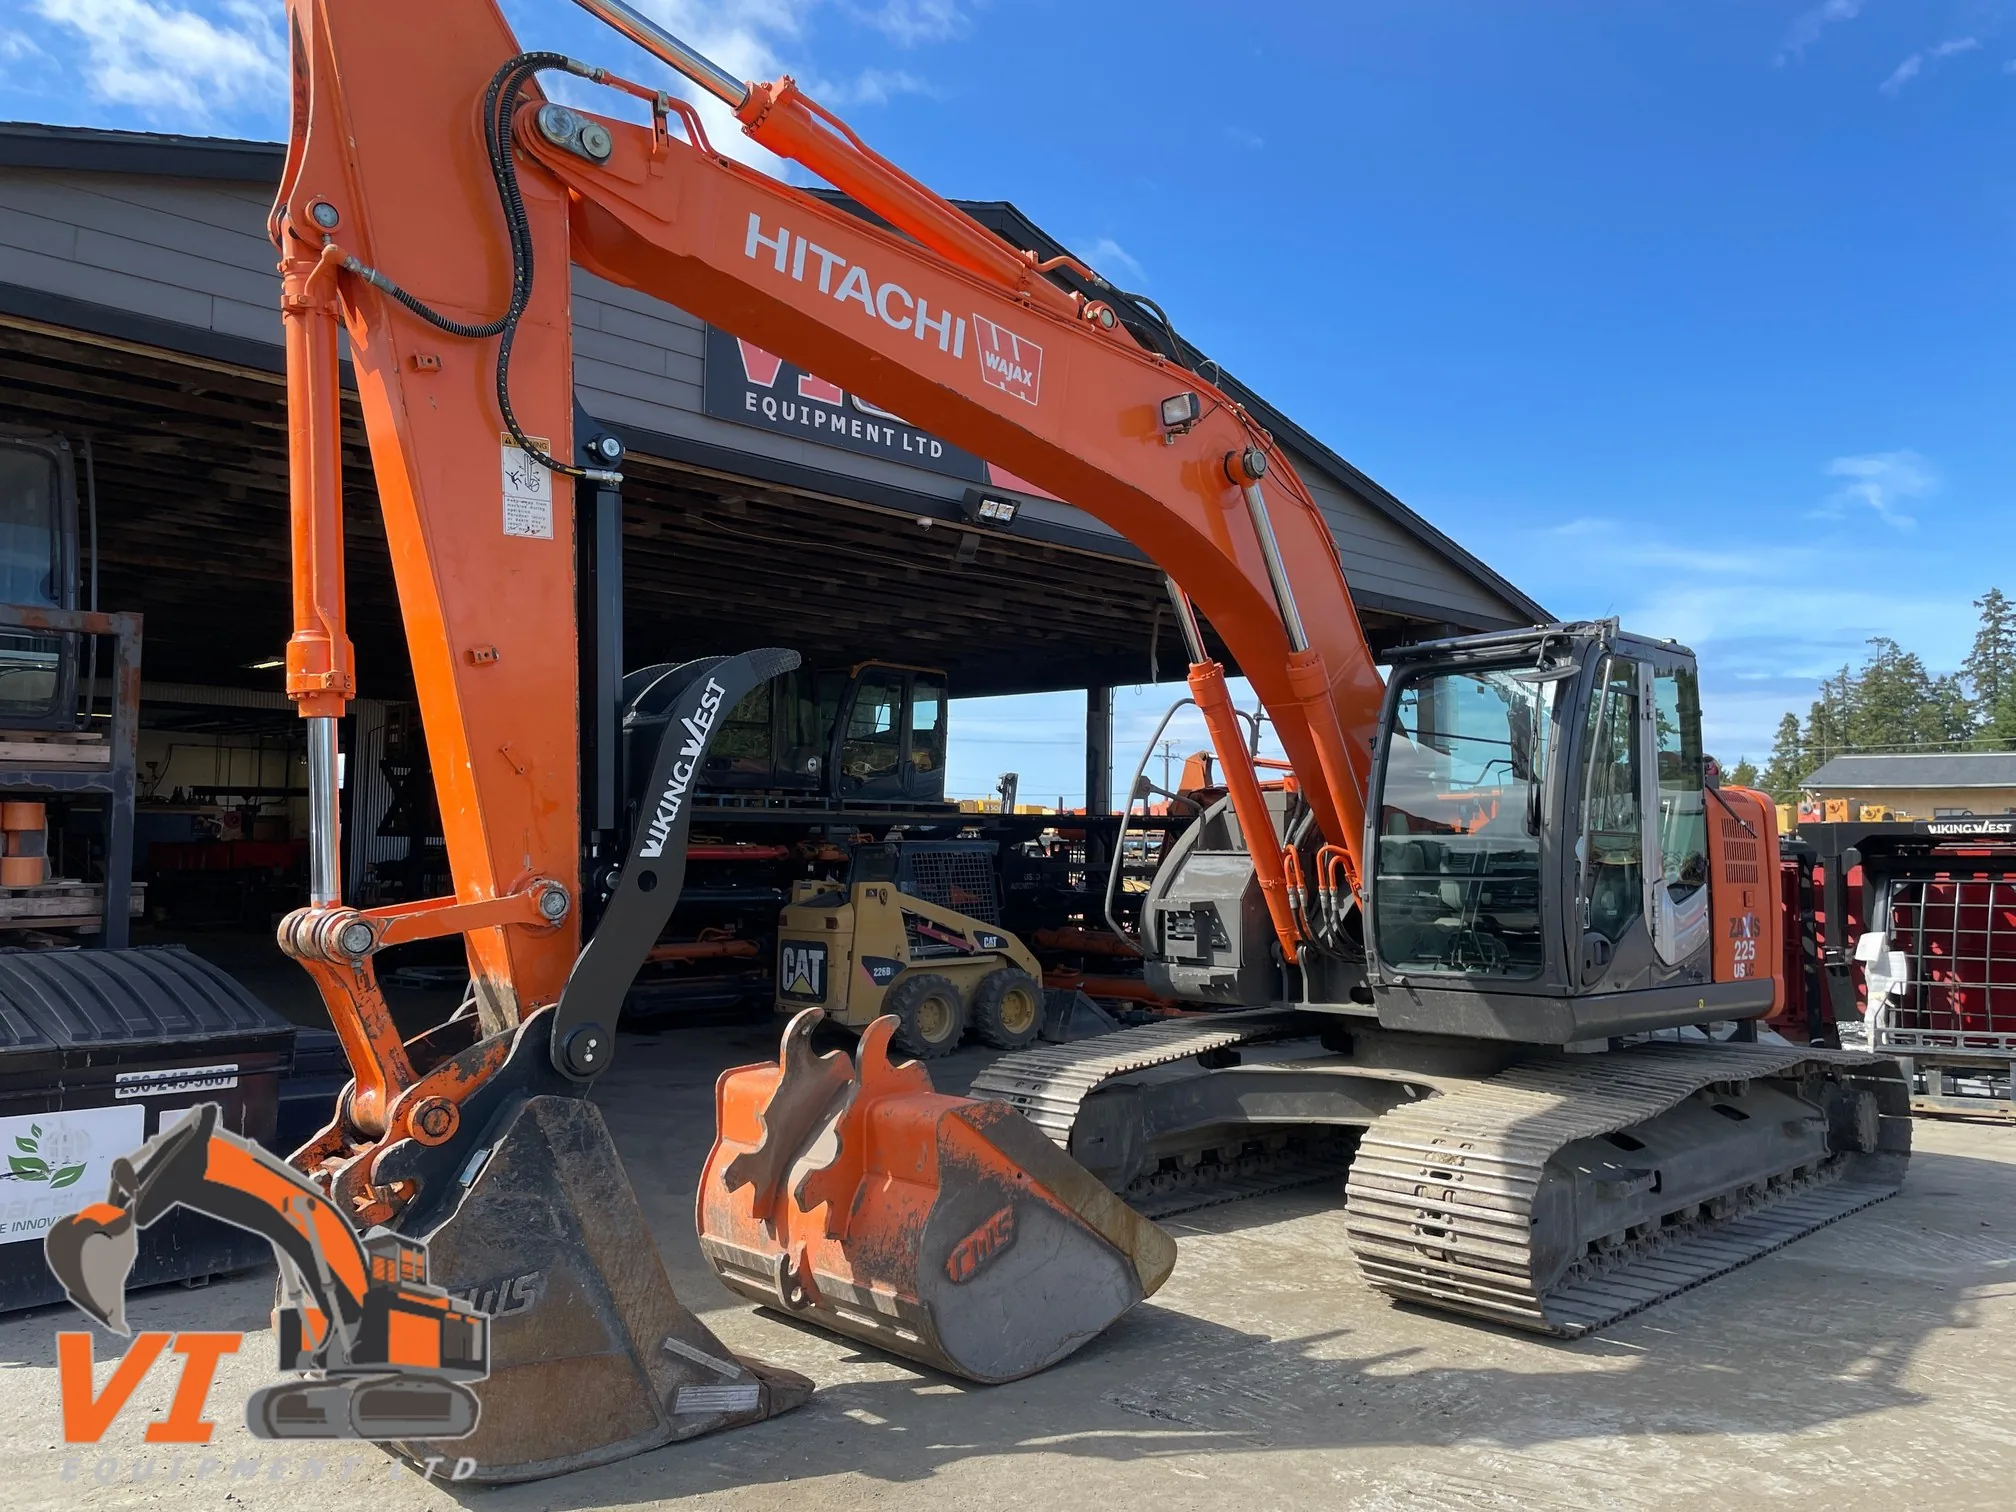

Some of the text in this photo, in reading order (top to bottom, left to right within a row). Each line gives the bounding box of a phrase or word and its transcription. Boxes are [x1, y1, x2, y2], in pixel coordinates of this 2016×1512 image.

[744, 211, 966, 359] HITACHI
[985, 350, 1032, 387] WAJAX
[745, 391, 943, 458] EQUIPMENT LTD
[1728, 911, 1760, 938] ZAXIS
[983, 936, 997, 948] CAT
[1734, 940, 1755, 961] 225
[782, 947, 825, 996] CAT
[12, 1215, 63, 1232] INNOV
